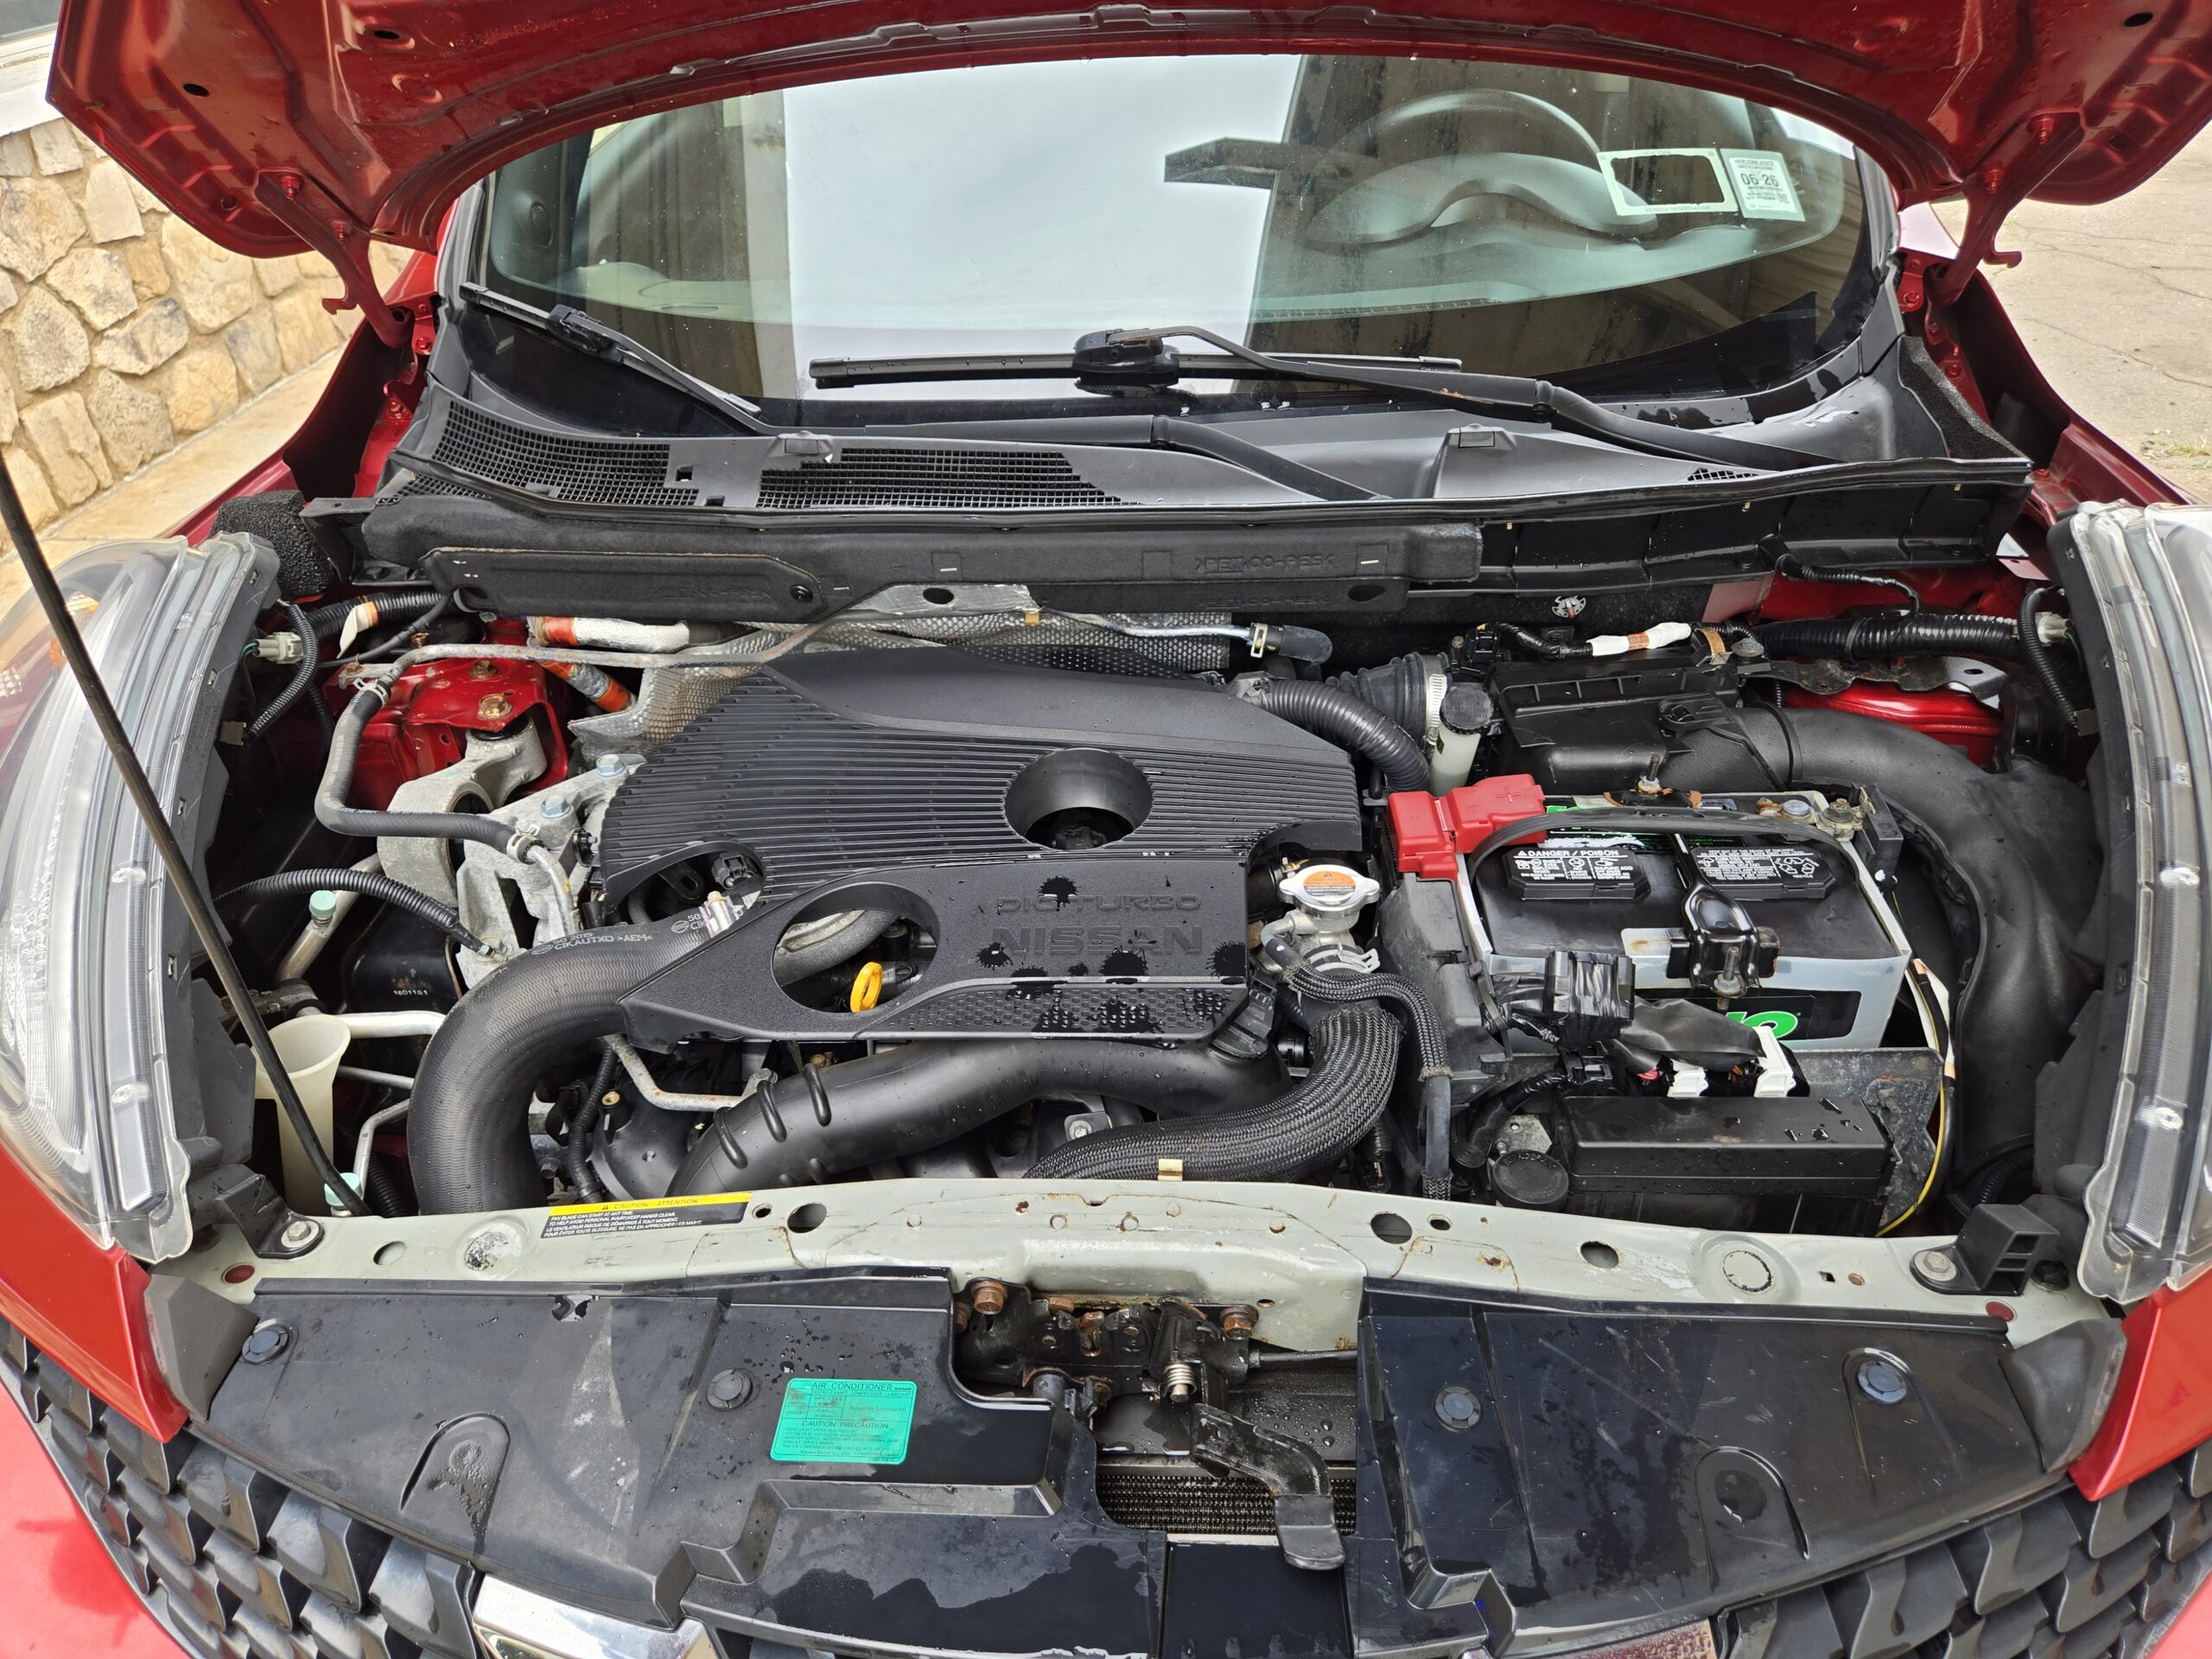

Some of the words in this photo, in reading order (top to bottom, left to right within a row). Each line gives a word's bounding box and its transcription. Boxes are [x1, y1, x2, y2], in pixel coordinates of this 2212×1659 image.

[688, 913, 701, 922] 50
[555, 935, 614, 950] CIKAUTXO
[994, 925, 1203, 953] NISSAN
